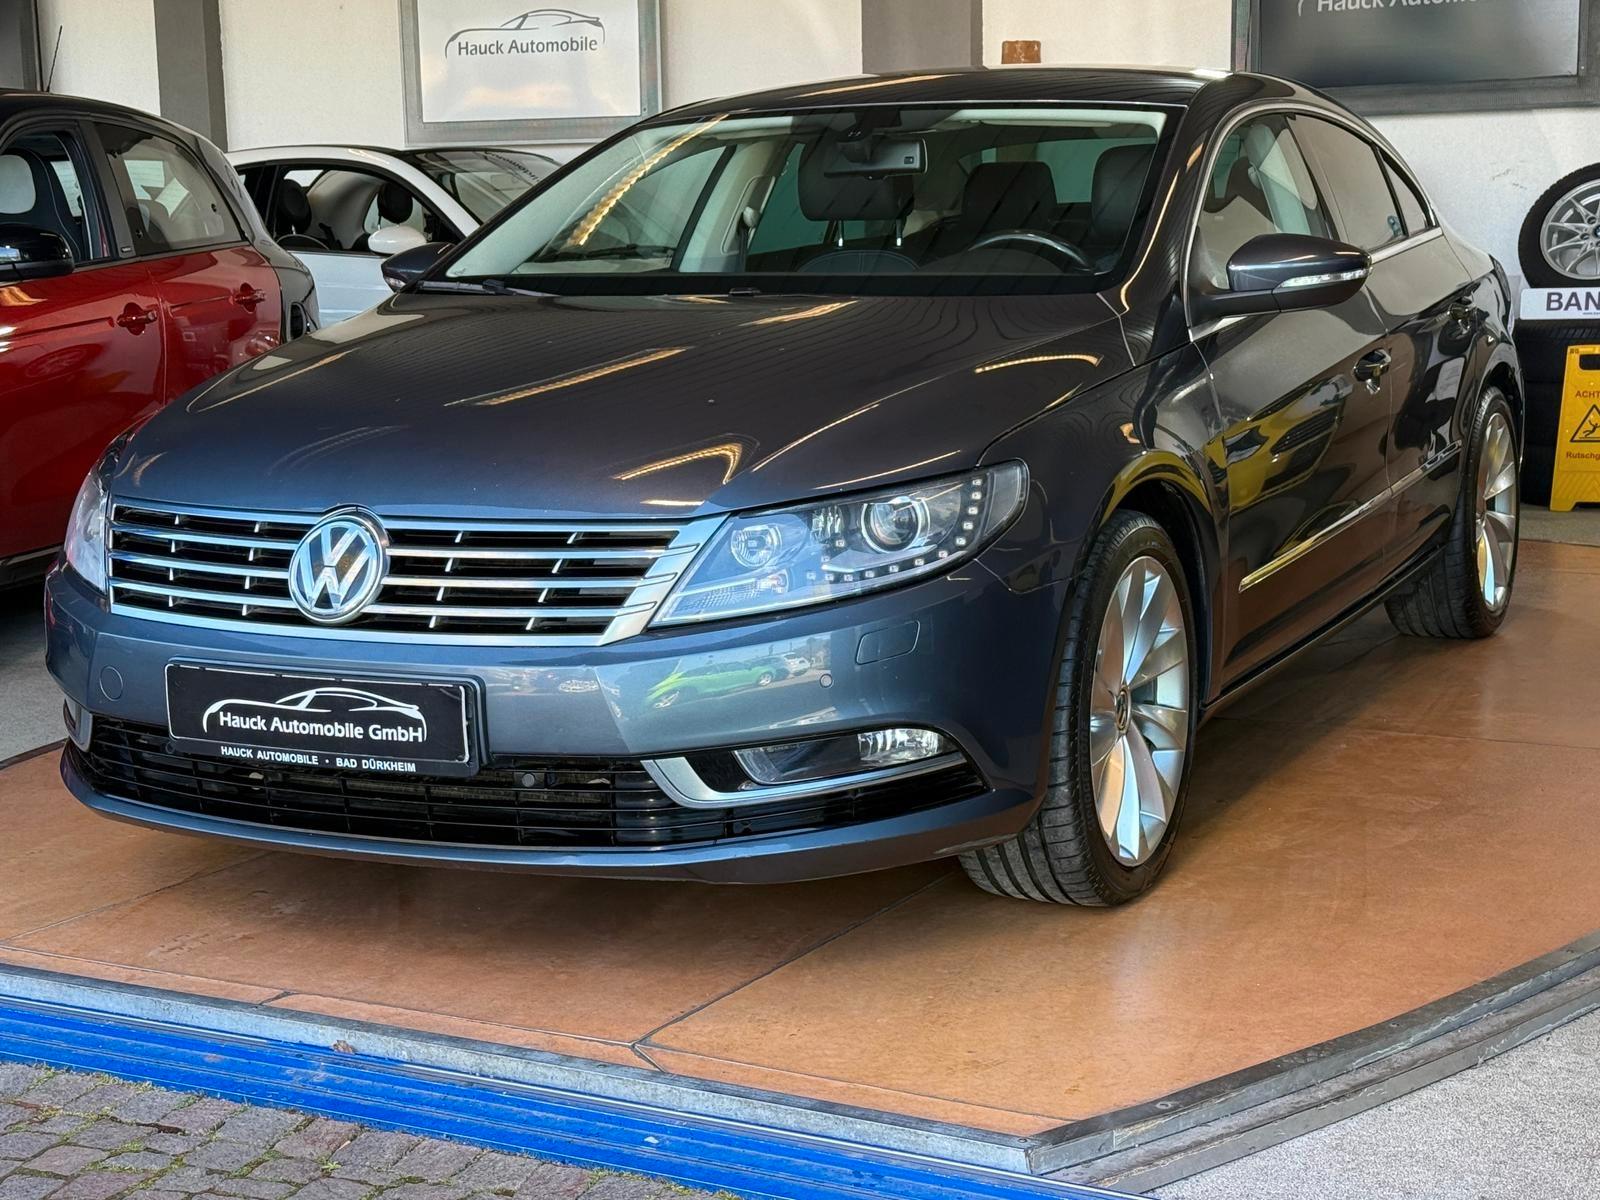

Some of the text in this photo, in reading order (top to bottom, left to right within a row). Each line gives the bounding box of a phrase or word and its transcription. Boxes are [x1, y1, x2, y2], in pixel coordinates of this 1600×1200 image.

[457, 36, 598, 56] Hauck Automobile
[1546, 291, 1600, 311] BAN
[219, 711, 423, 742] Hauck Automobile GmbH
[220, 745, 417, 773] HAUCK AUTOMOBILE BAD DÜRKHEIM
